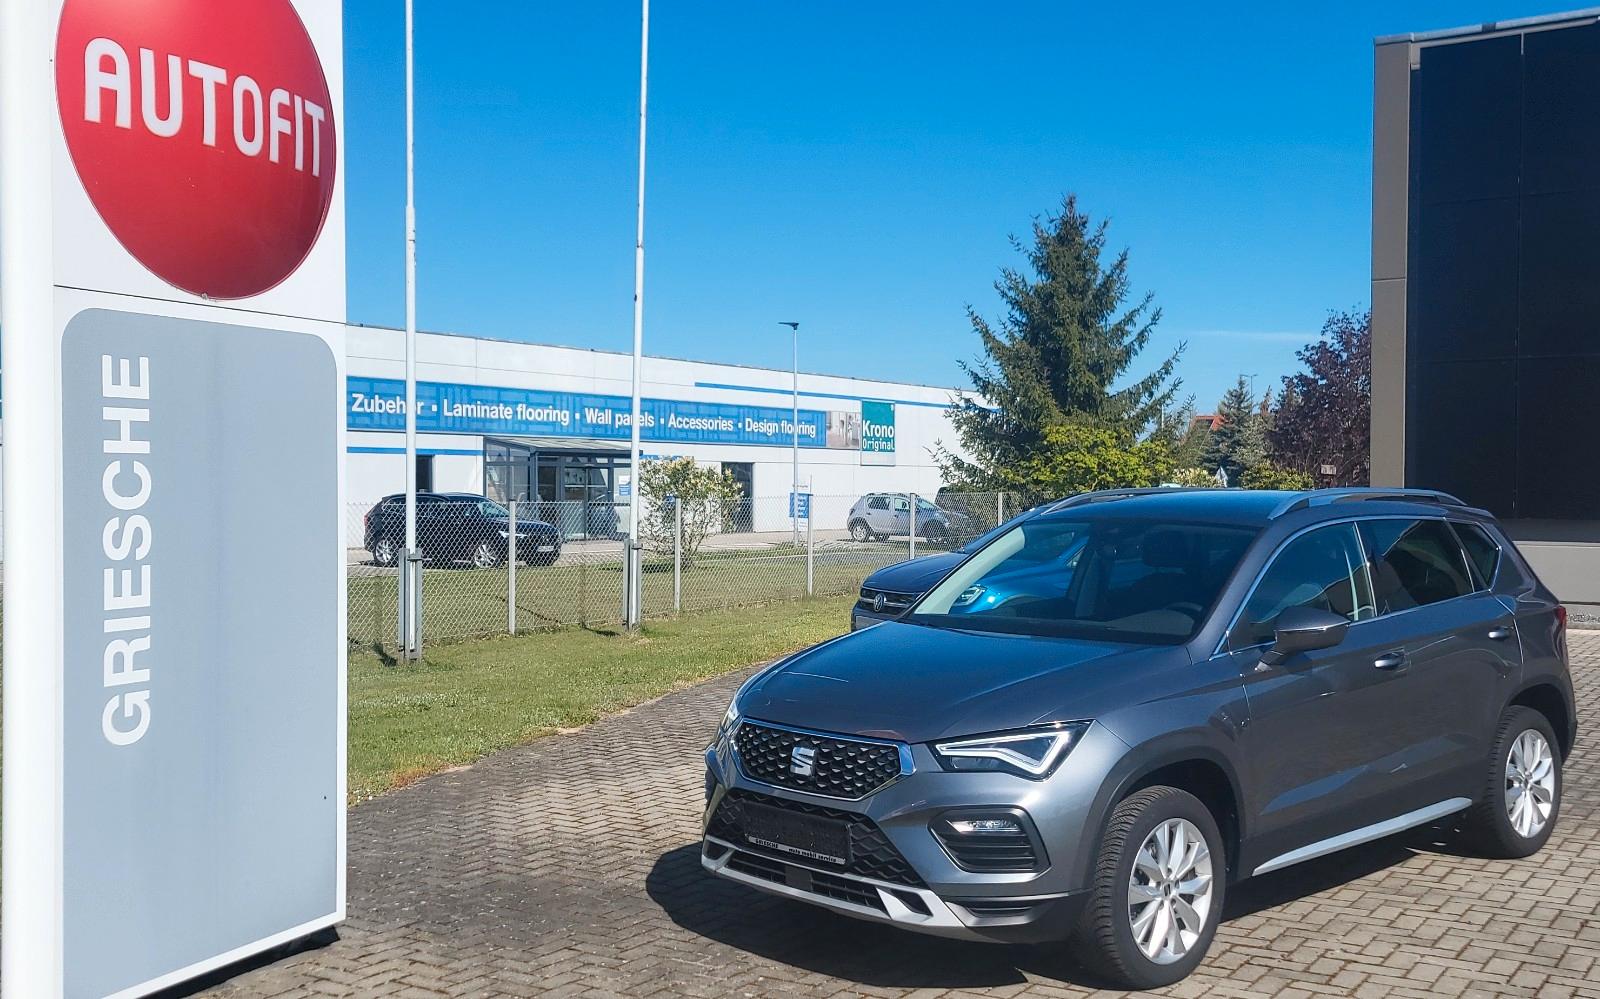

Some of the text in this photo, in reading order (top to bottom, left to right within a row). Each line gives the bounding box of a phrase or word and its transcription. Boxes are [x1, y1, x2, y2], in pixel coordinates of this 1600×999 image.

[84, 37, 325, 177] AUTOFIT
[351, 393, 424, 415] Zubehr
[443, 399, 513, 420] Laminate
[516, 403, 570, 426] flooring
[584, 407, 612, 425] Wall
[615, 411, 655, 429] paels
[668, 413, 734, 431] Accessories
[745, 418, 779, 436] Design
[862, 420, 895, 438] Krono
[862, 438, 895, 452] Original
[102, 354, 152, 746] GRIESCHE
